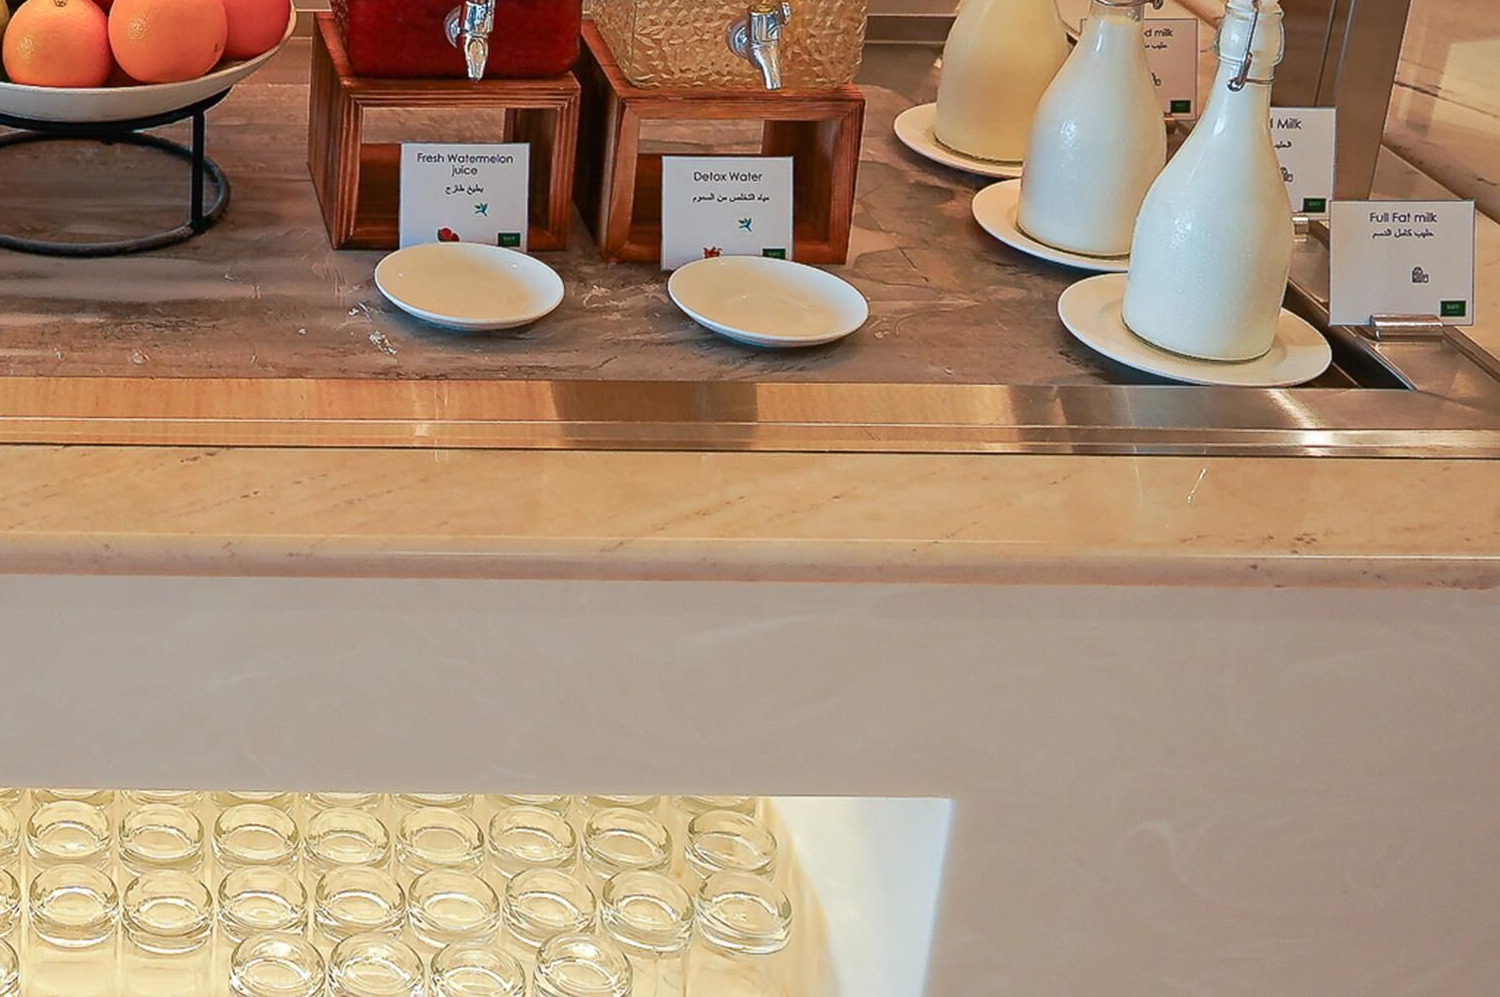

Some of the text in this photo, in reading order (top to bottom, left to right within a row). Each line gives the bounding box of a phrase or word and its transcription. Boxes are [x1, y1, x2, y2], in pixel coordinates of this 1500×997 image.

[1276, 117, 1303, 130] Milk
[416, 152, 514, 164] Fresh Watermelon
[451, 164, 478, 177] juice
[693, 171, 763, 183] Detox Water
[1369, 211, 1438, 223] Full Fat milk
